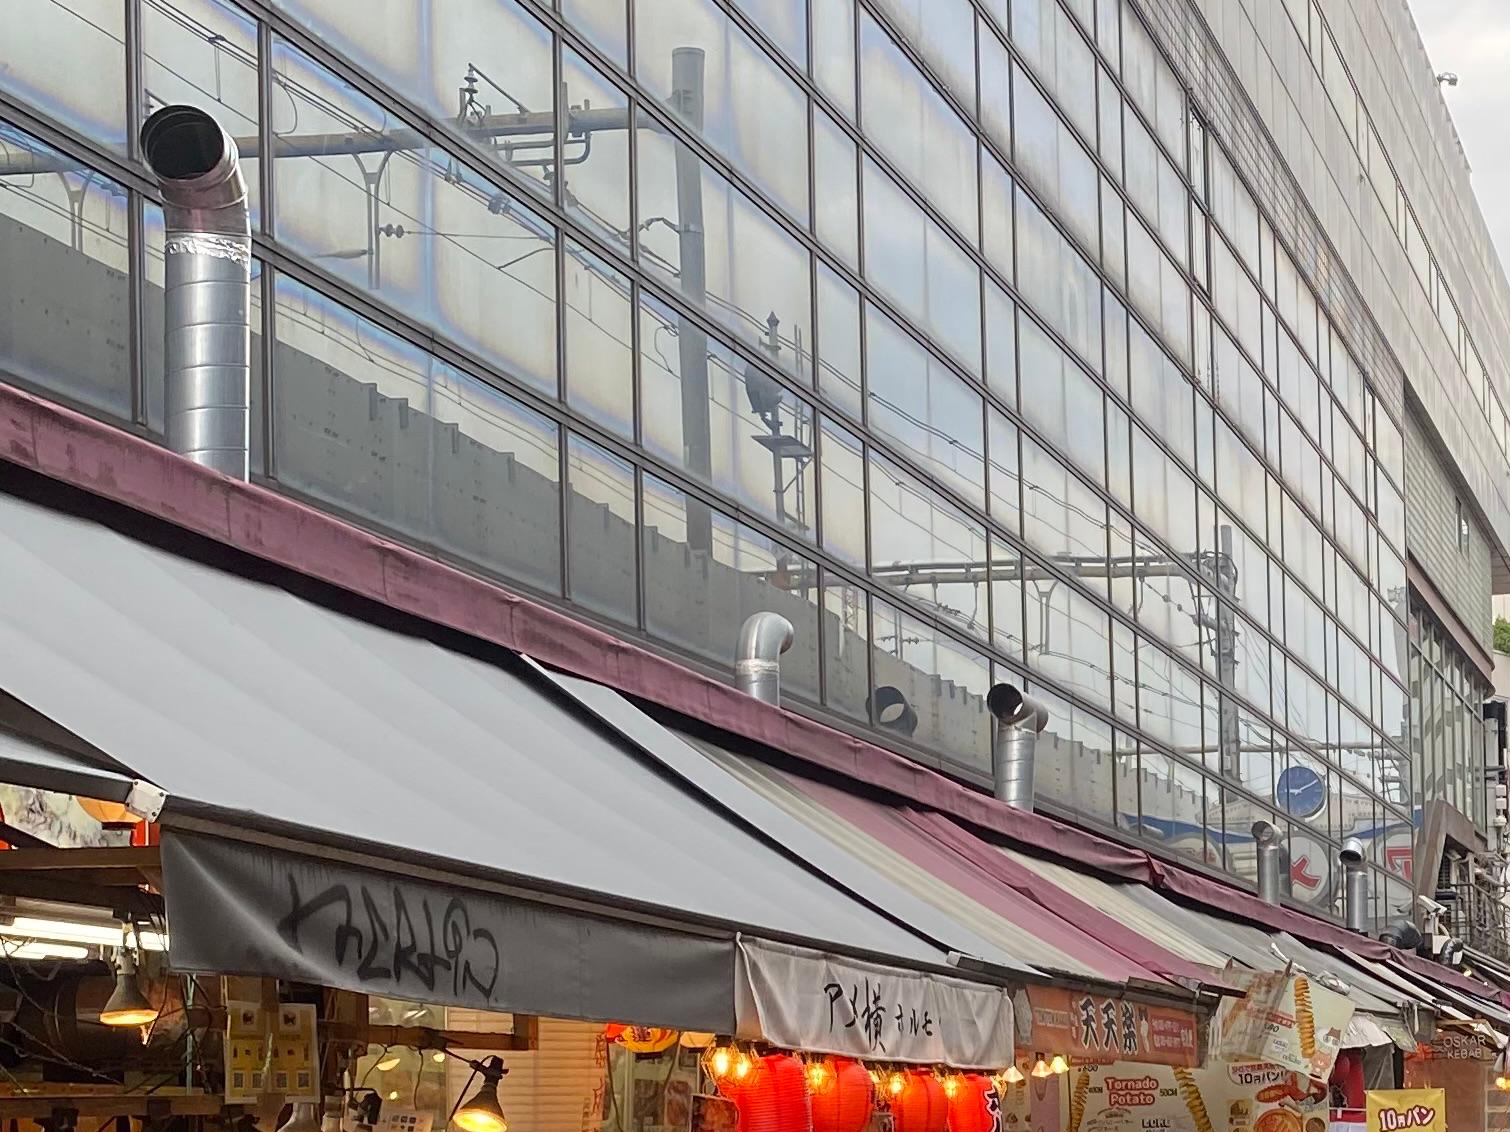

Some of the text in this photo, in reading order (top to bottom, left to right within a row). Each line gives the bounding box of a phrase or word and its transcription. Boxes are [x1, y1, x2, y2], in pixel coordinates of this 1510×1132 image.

[1443, 1034, 1486, 1048] OSKAR
[1447, 1049, 1482, 1060] KEBAB
[1105, 1077, 1158, 1090] Tornado
[1110, 1093, 1155, 1106] Potato
[1378, 1105, 1435, 1132] 10円パン
